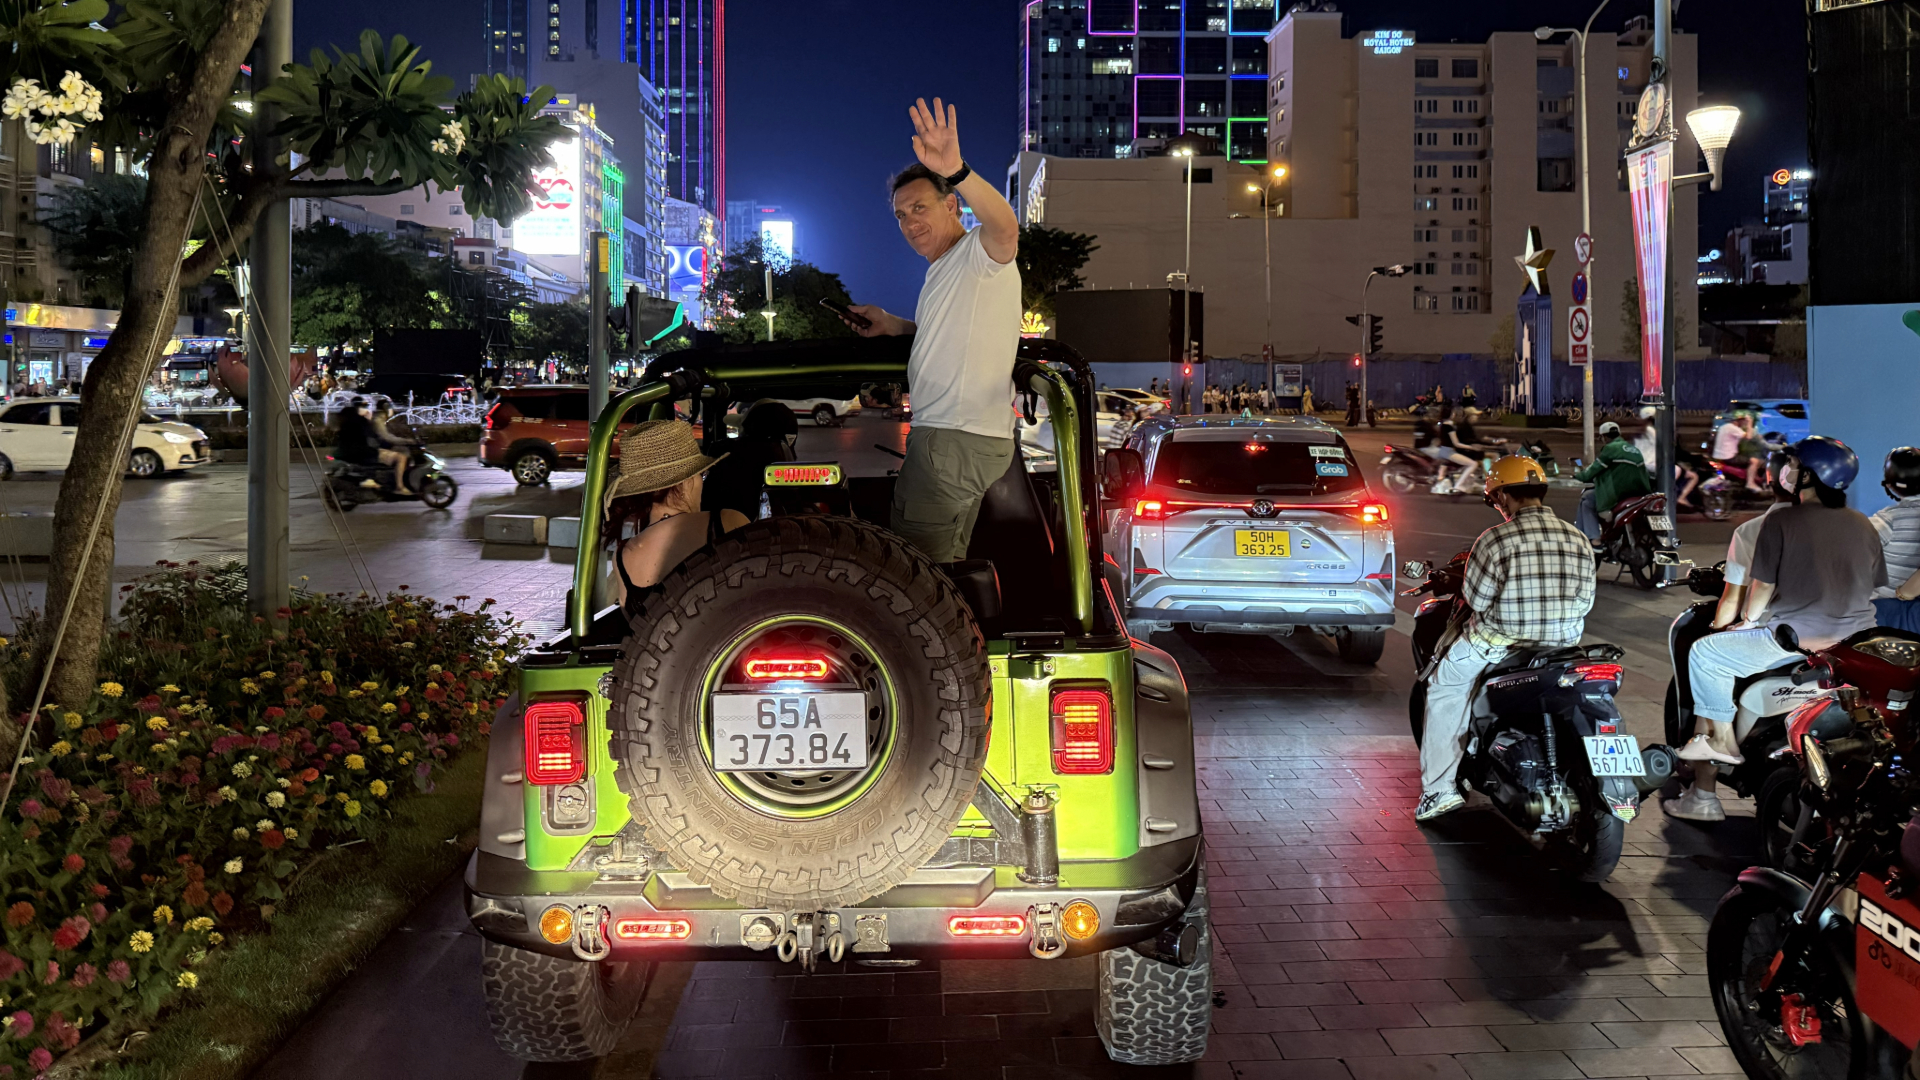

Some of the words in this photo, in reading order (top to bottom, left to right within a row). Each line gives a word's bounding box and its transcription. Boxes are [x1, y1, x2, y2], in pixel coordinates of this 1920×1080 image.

[1321, 466, 1344, 474] Grab
[1250, 532, 1274, 543] 50H
[1241, 544, 1285, 555] 363.25
[1772, 687, 1796, 697] SH
[756, 697, 822, 729] 65A
[729, 732, 851, 765] 373.84
[1591, 738, 1632, 755] 72D1
[1591, 756, 1643, 774] 567.40
[661, 718, 778, 852] COUNTRY
[788, 808, 884, 857] OPEN
